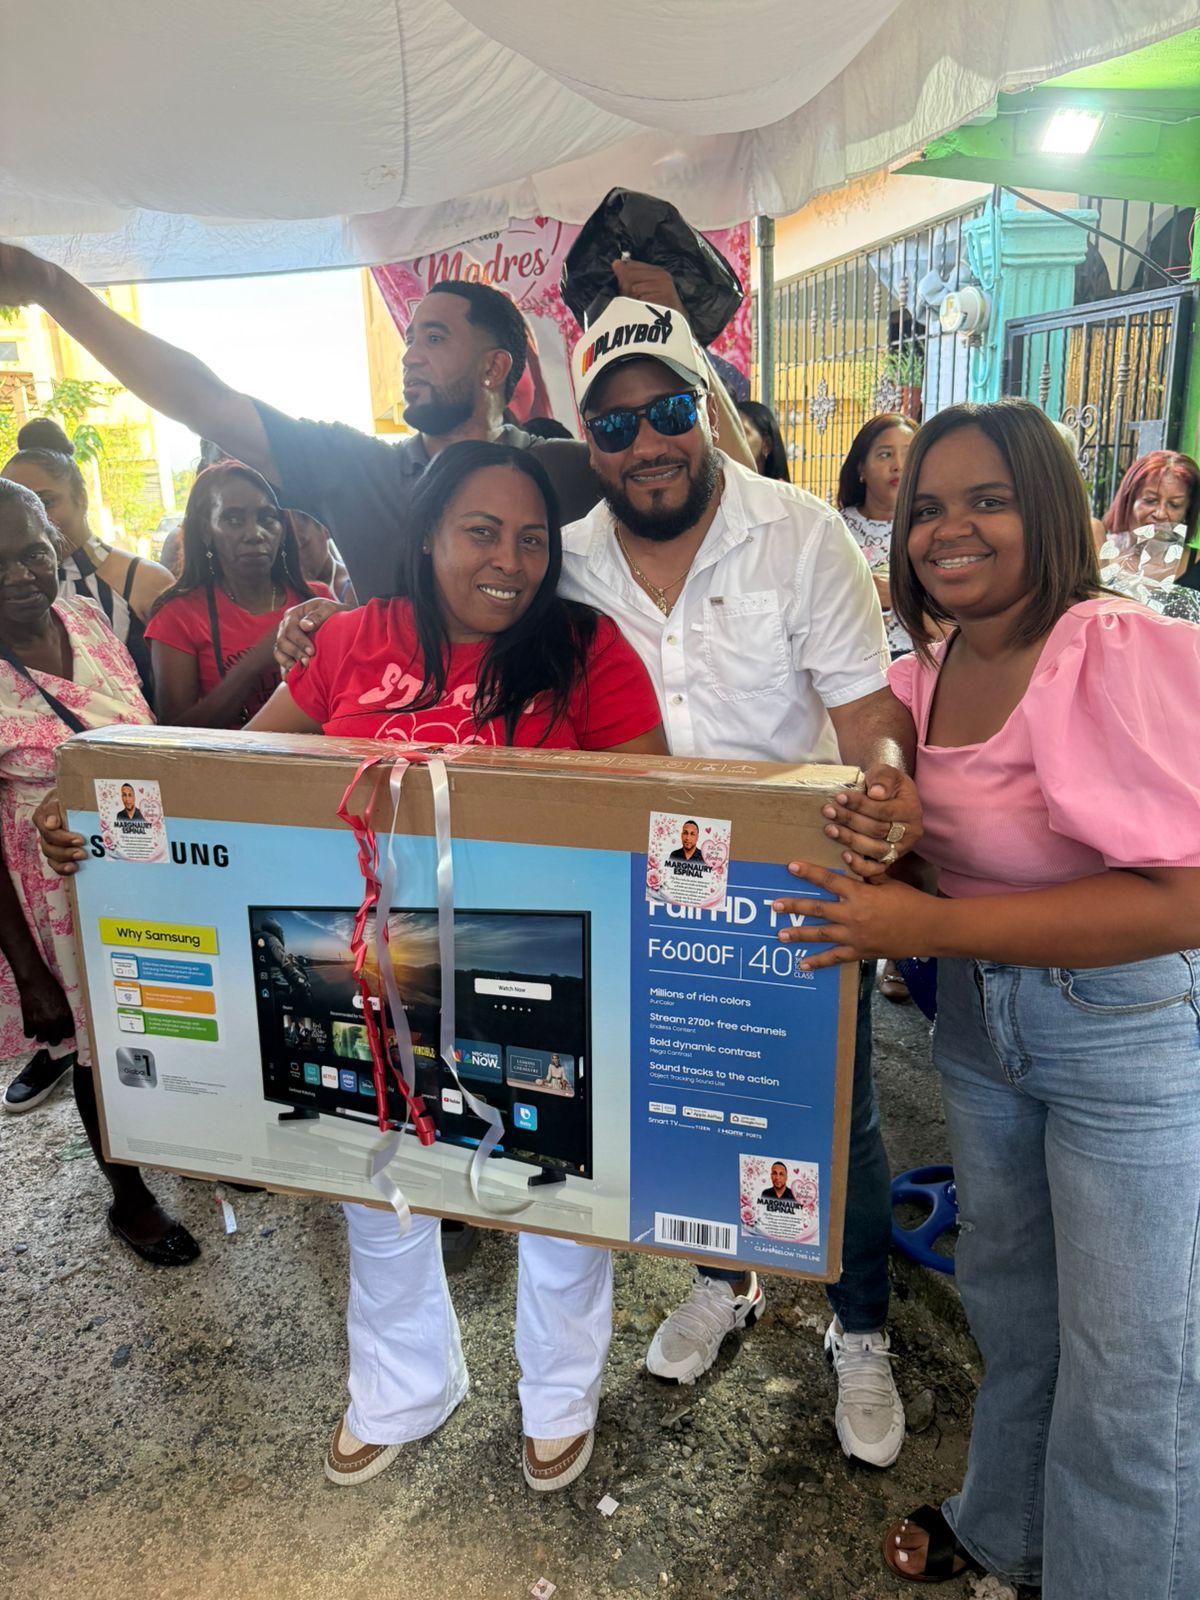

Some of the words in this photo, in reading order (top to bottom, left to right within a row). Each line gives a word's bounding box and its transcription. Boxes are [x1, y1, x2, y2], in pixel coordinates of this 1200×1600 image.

[413, 243, 549, 291] Madres
[594, 323, 673, 362] PLAYBOY
[90, 834, 229, 867] SUNG
[664, 860, 713, 873] MARGNAURY
[673, 868, 703, 878] ESPINAL
[117, 927, 142, 942] Why
[145, 930, 200, 948] Samsung
[648, 938, 735, 965] F6000F
[794, 972, 815, 981] CLASS
[498, 984, 513, 992] Watch
[650, 987, 685, 999] Millions
[686, 991, 697, 1000] of
[698, 992, 718, 1003] rich
[719, 996, 752, 1007] colors
[649, 1012, 686, 1024] Stream
[688, 1017, 715, 1027] 2700+
[717, 1019, 738, 1031] free
[740, 1023, 787, 1037] channels
[649, 1037, 671, 1047] Bold
[672, 1040, 716, 1053] dynamic
[718, 1047, 761, 1059] contrast
[667, 1049, 692, 1058] Contrast
[649, 1061, 680, 1073] Sound
[682, 1065, 714, 1077] tracks
[715, 1070, 726, 1079] to
[728, 1071, 745, 1081] the
[747, 1075, 780, 1086] action
[648, 1117, 669, 1126] Smart
[756, 1198, 804, 1210] MARGNAURY
[766, 1204, 795, 1215] ESPINAL
